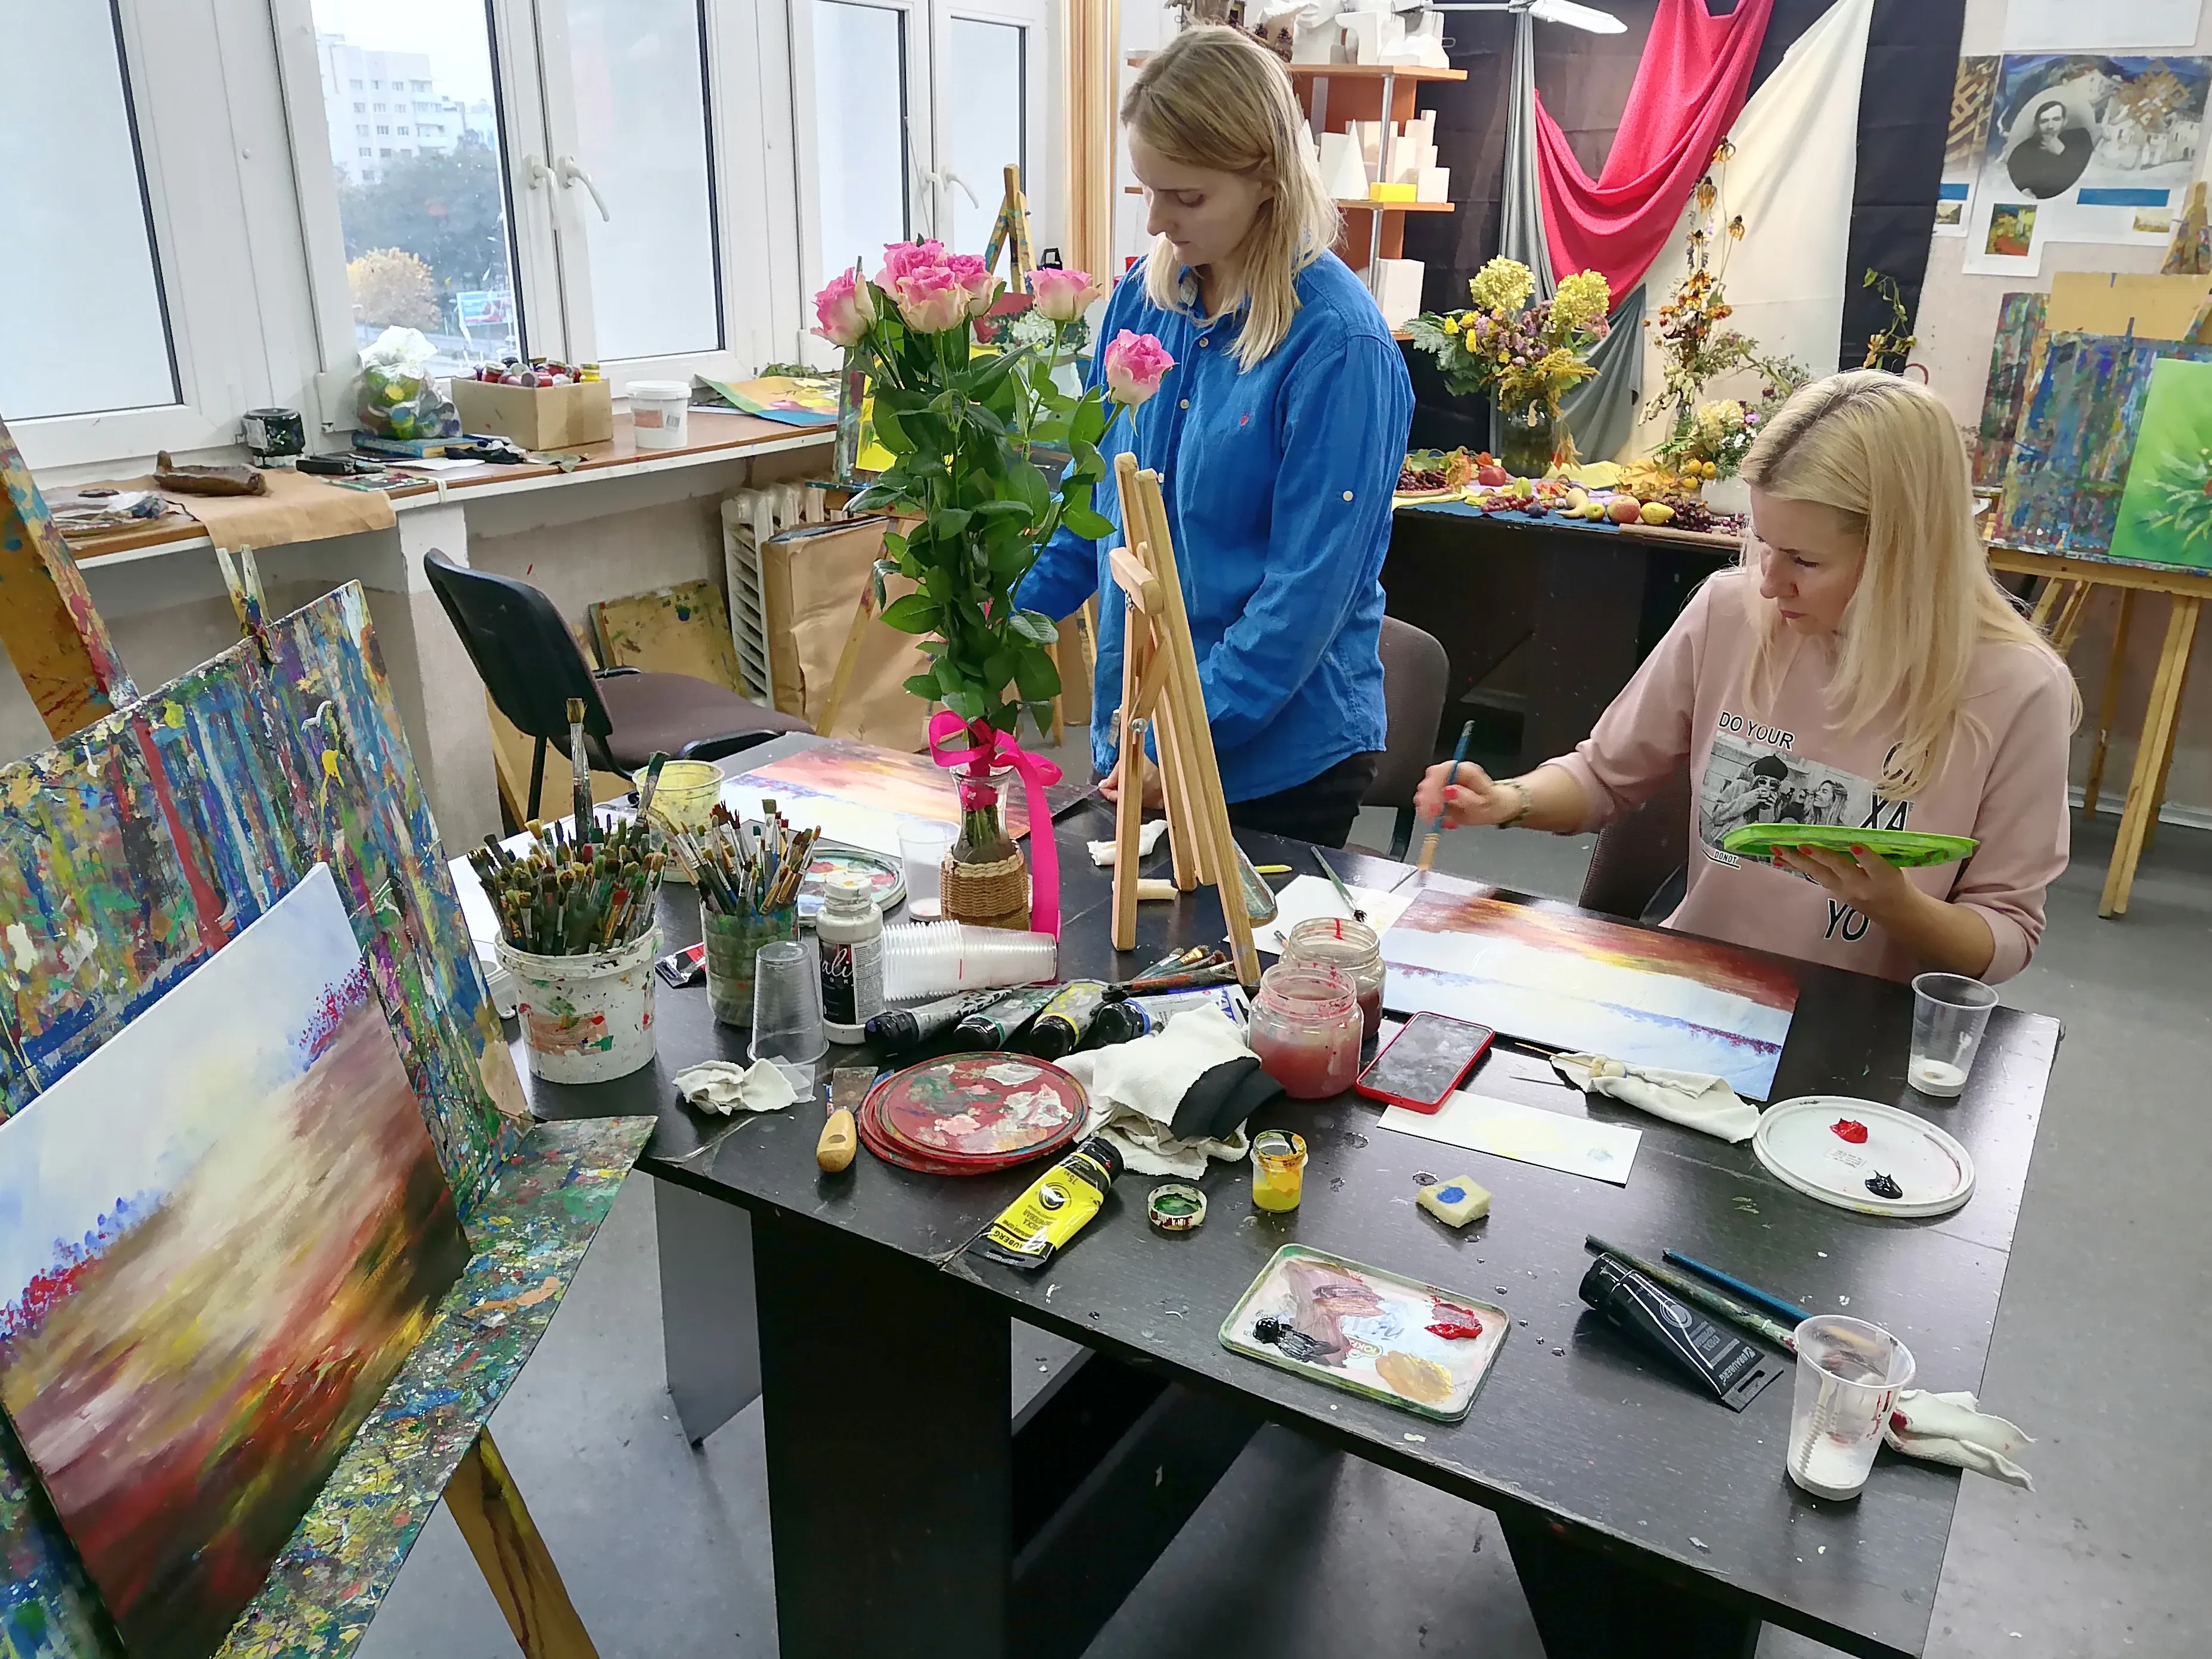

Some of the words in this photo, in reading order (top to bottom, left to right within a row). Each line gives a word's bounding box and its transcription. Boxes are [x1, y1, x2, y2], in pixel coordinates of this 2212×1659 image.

[1718, 711, 1743, 732] DO
[1746, 720, 1795, 751] YOUR
[1718, 1354, 1749, 1383] BRAUBERG
